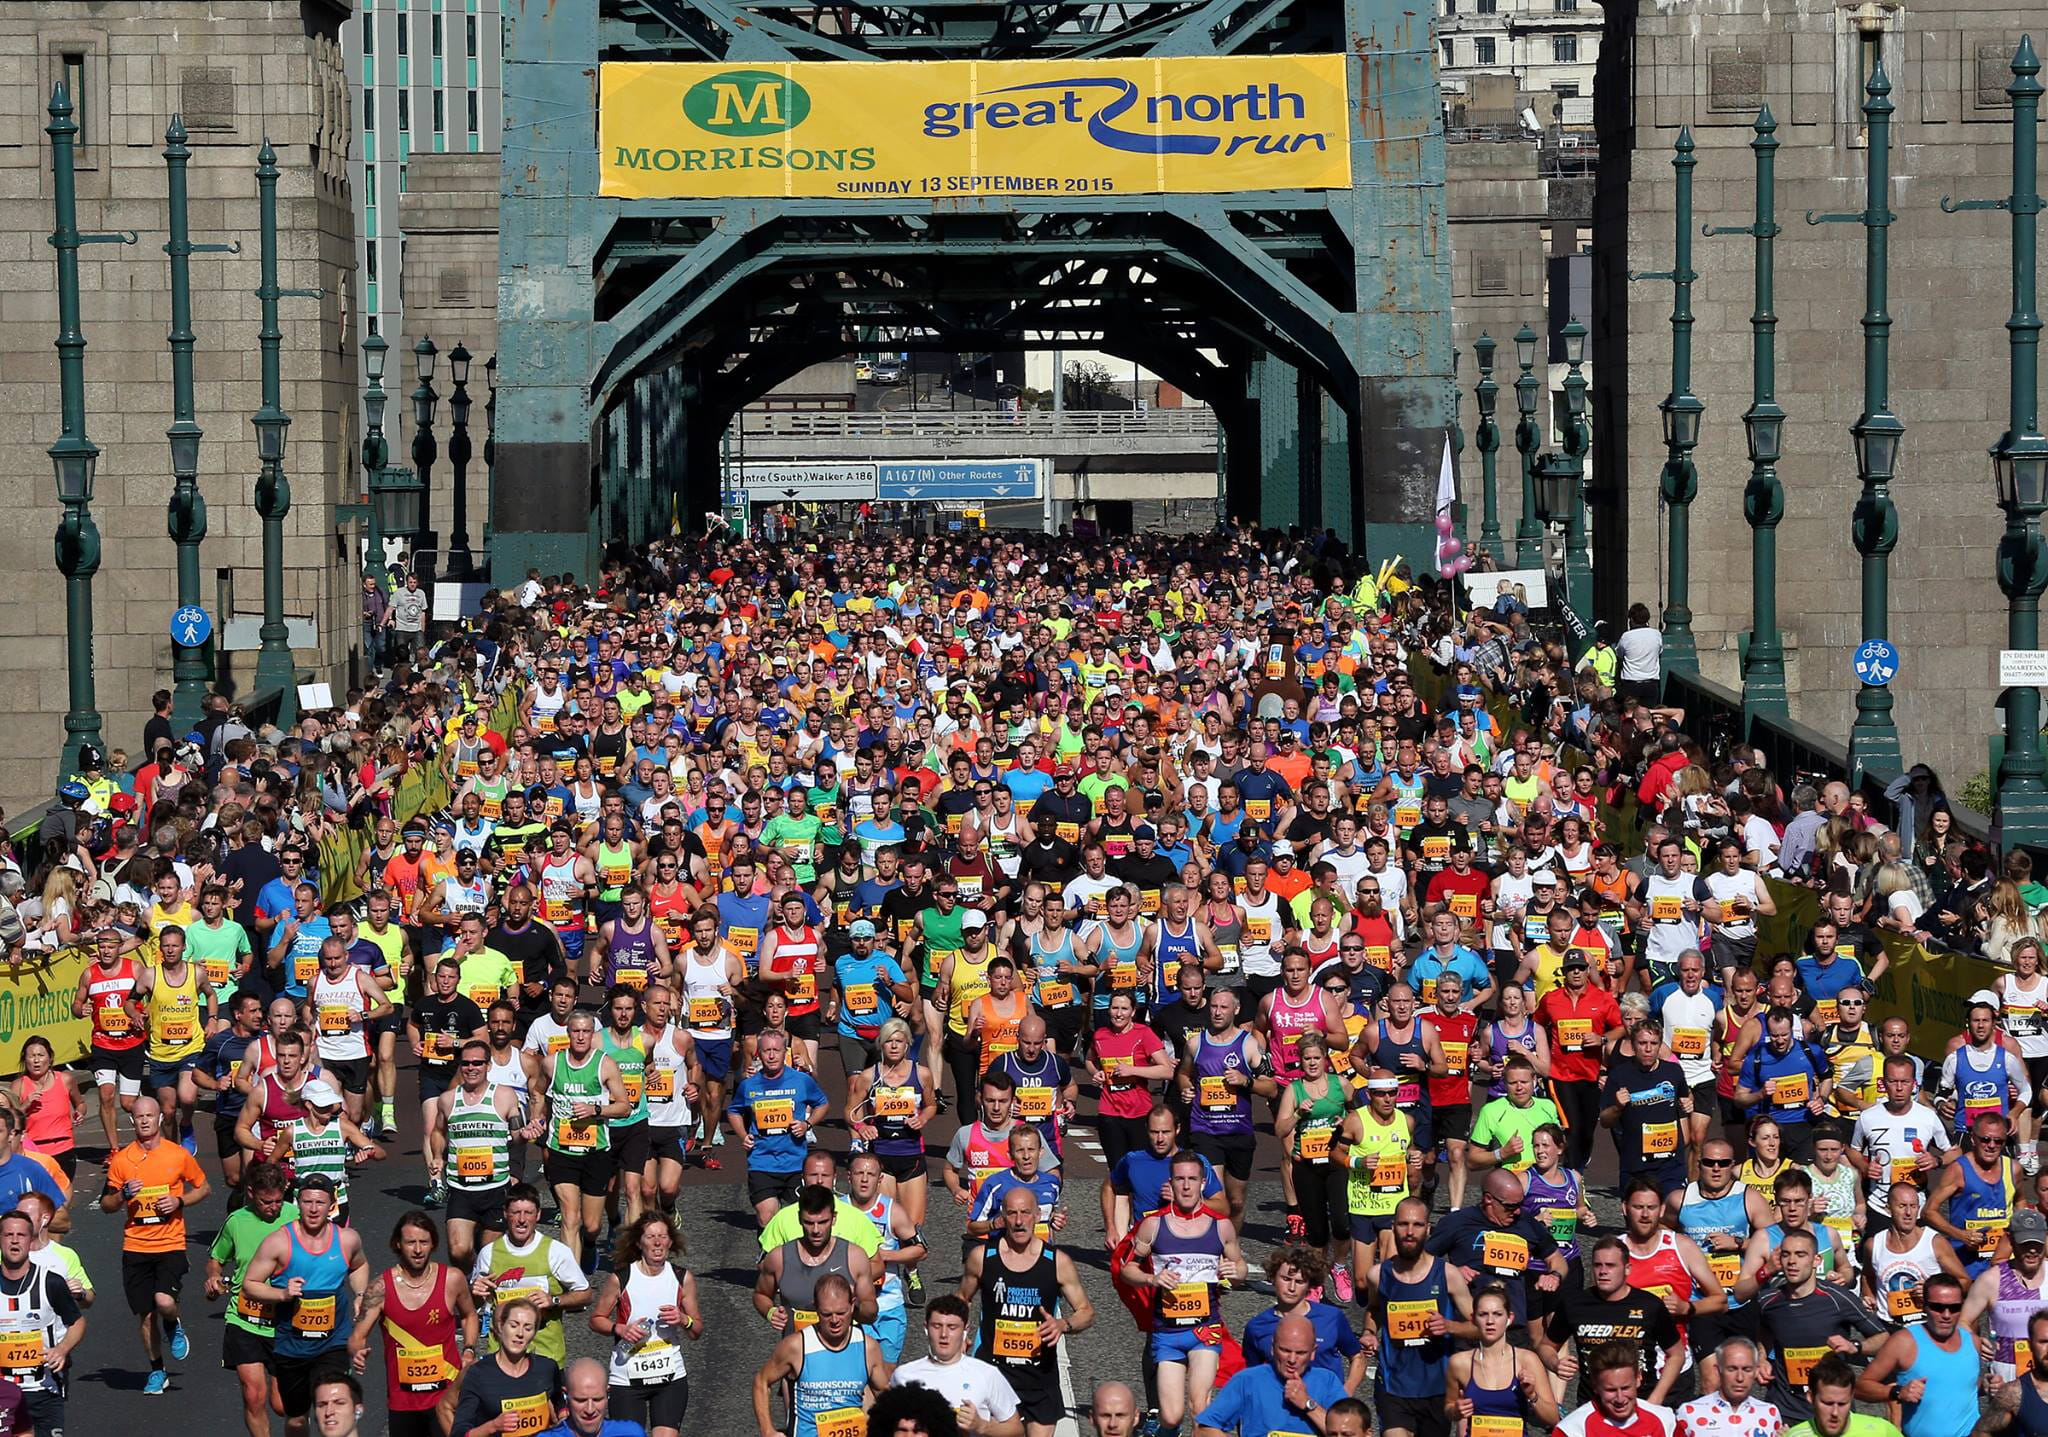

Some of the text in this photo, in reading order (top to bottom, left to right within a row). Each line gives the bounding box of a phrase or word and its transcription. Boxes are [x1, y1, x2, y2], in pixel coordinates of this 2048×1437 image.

[707, 82, 785, 125] M
[923, 83, 1305, 138] great north
[1224, 130, 1327, 157] run
[614, 146, 876, 171] MORRISONS
[837, 176, 1114, 193] SUNDAY 13 SEPTEMBER 2015
[809, 472, 843, 482] Walker
[938, 470, 966, 481] Other
[970, 469, 1003, 480] Routes
[1657, 907, 1677, 915] 3160
[851, 995, 872, 1005] 5303
[1047, 989, 1069, 1000] 2869
[696, 1009, 718, 1018] 5820
[105, 1017, 127, 1028] 5979
[167, 1026, 189, 1036] 6302
[1678, 1041, 1701, 1050] 4233
[563, 1082, 588, 1094] PAUL
[645, 1081, 668, 1092] 2951
[1022, 1077, 1042, 1088] DAD
[1207, 1091, 1231, 1100] 5653
[1779, 1088, 1803, 1099] 1556
[1022, 1101, 1046, 1111] 5502
[764, 1113, 787, 1124] 4870
[451, 1121, 495, 1132] DERWENT
[565, 1131, 591, 1141] 4989
[297, 1139, 340, 1149] DERWENT
[1650, 1137, 1674, 1147] 4625
[462, 1161, 487, 1171] 4005
[1378, 1170, 1401, 1180] 1911
[1489, 1247, 1525, 1264] 56176
[1007, 1287, 1039, 1297] PROSTATE
[1007, 1296, 1041, 1305] CANCER UK
[1171, 1300, 1202, 1312] 5689
[1001, 1304, 1035, 1319] ANDY
[300, 1314, 330, 1327] 3703
[1002, 1338, 1034, 1351] 6596
[7, 1349, 38, 1361] 4742
[633, 1357, 671, 1373] 16437
[407, 1364, 438, 1378] 5322
